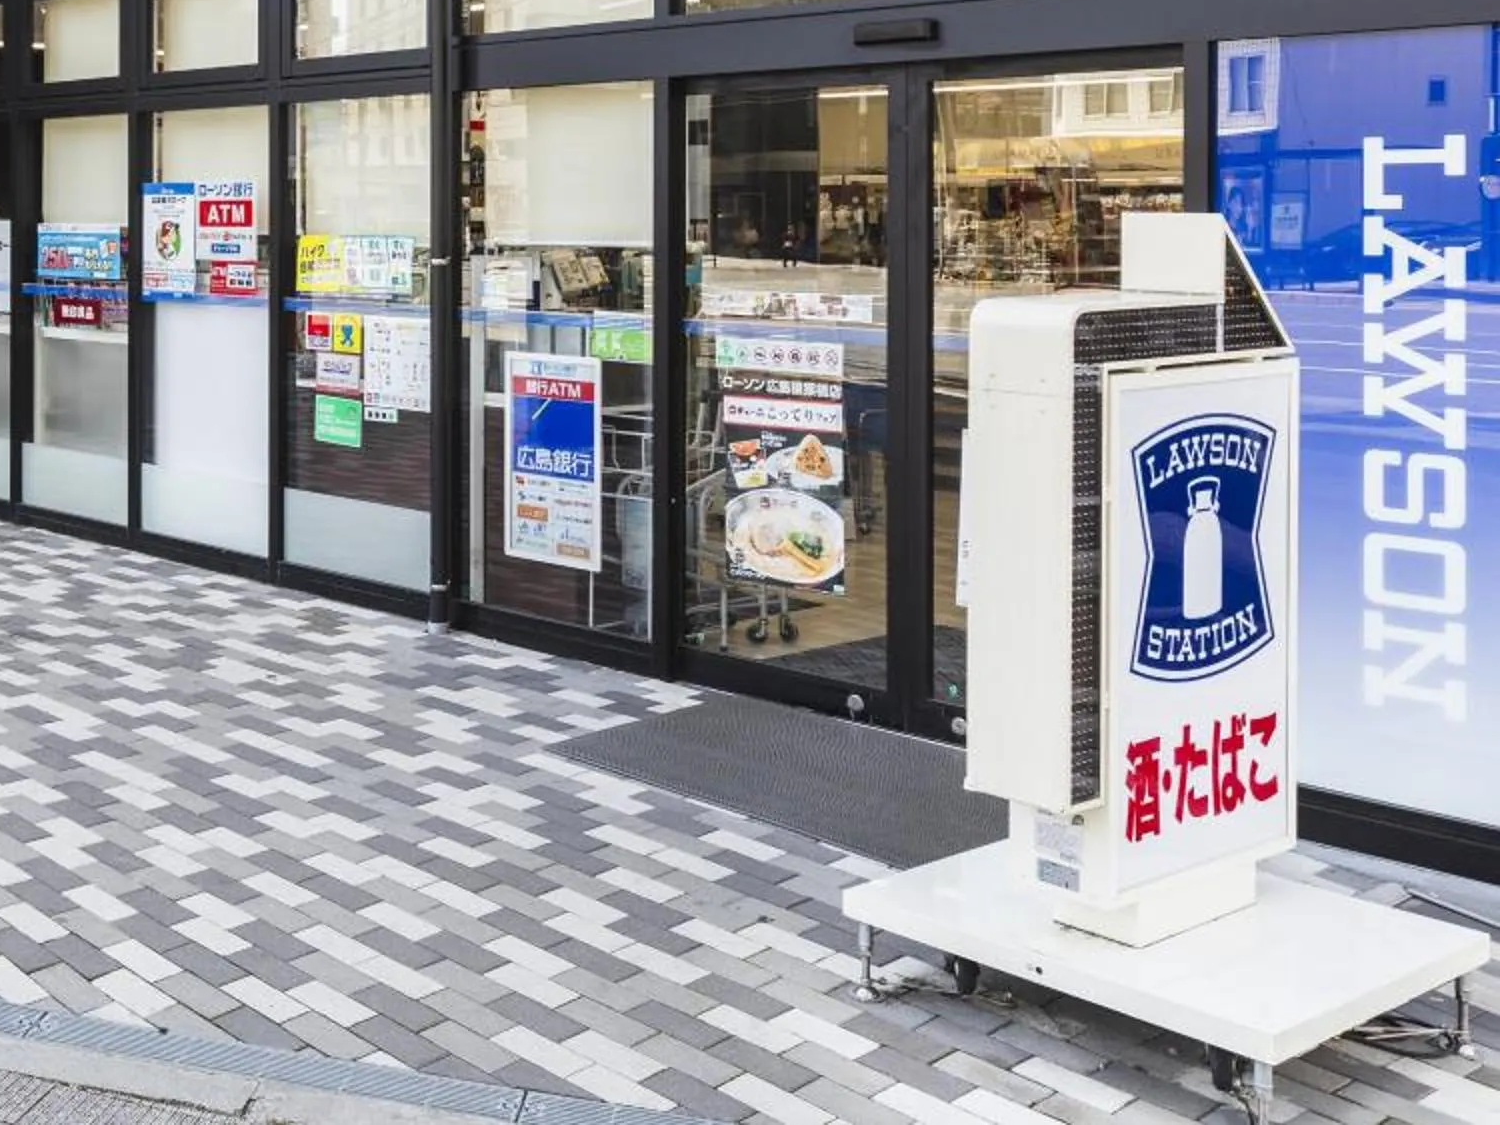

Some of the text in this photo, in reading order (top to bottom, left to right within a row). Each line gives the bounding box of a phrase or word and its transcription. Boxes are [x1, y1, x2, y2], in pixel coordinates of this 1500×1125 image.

[207, 204, 245, 224] ATM
[1363, 134, 1466, 722] LAWSON
[516, 446, 592, 478] 広島銀行
[1146, 432, 1261, 489] LAWSON
[1147, 603, 1258, 663] STATION
[1125, 711, 1278, 843] 酒・たばこ
